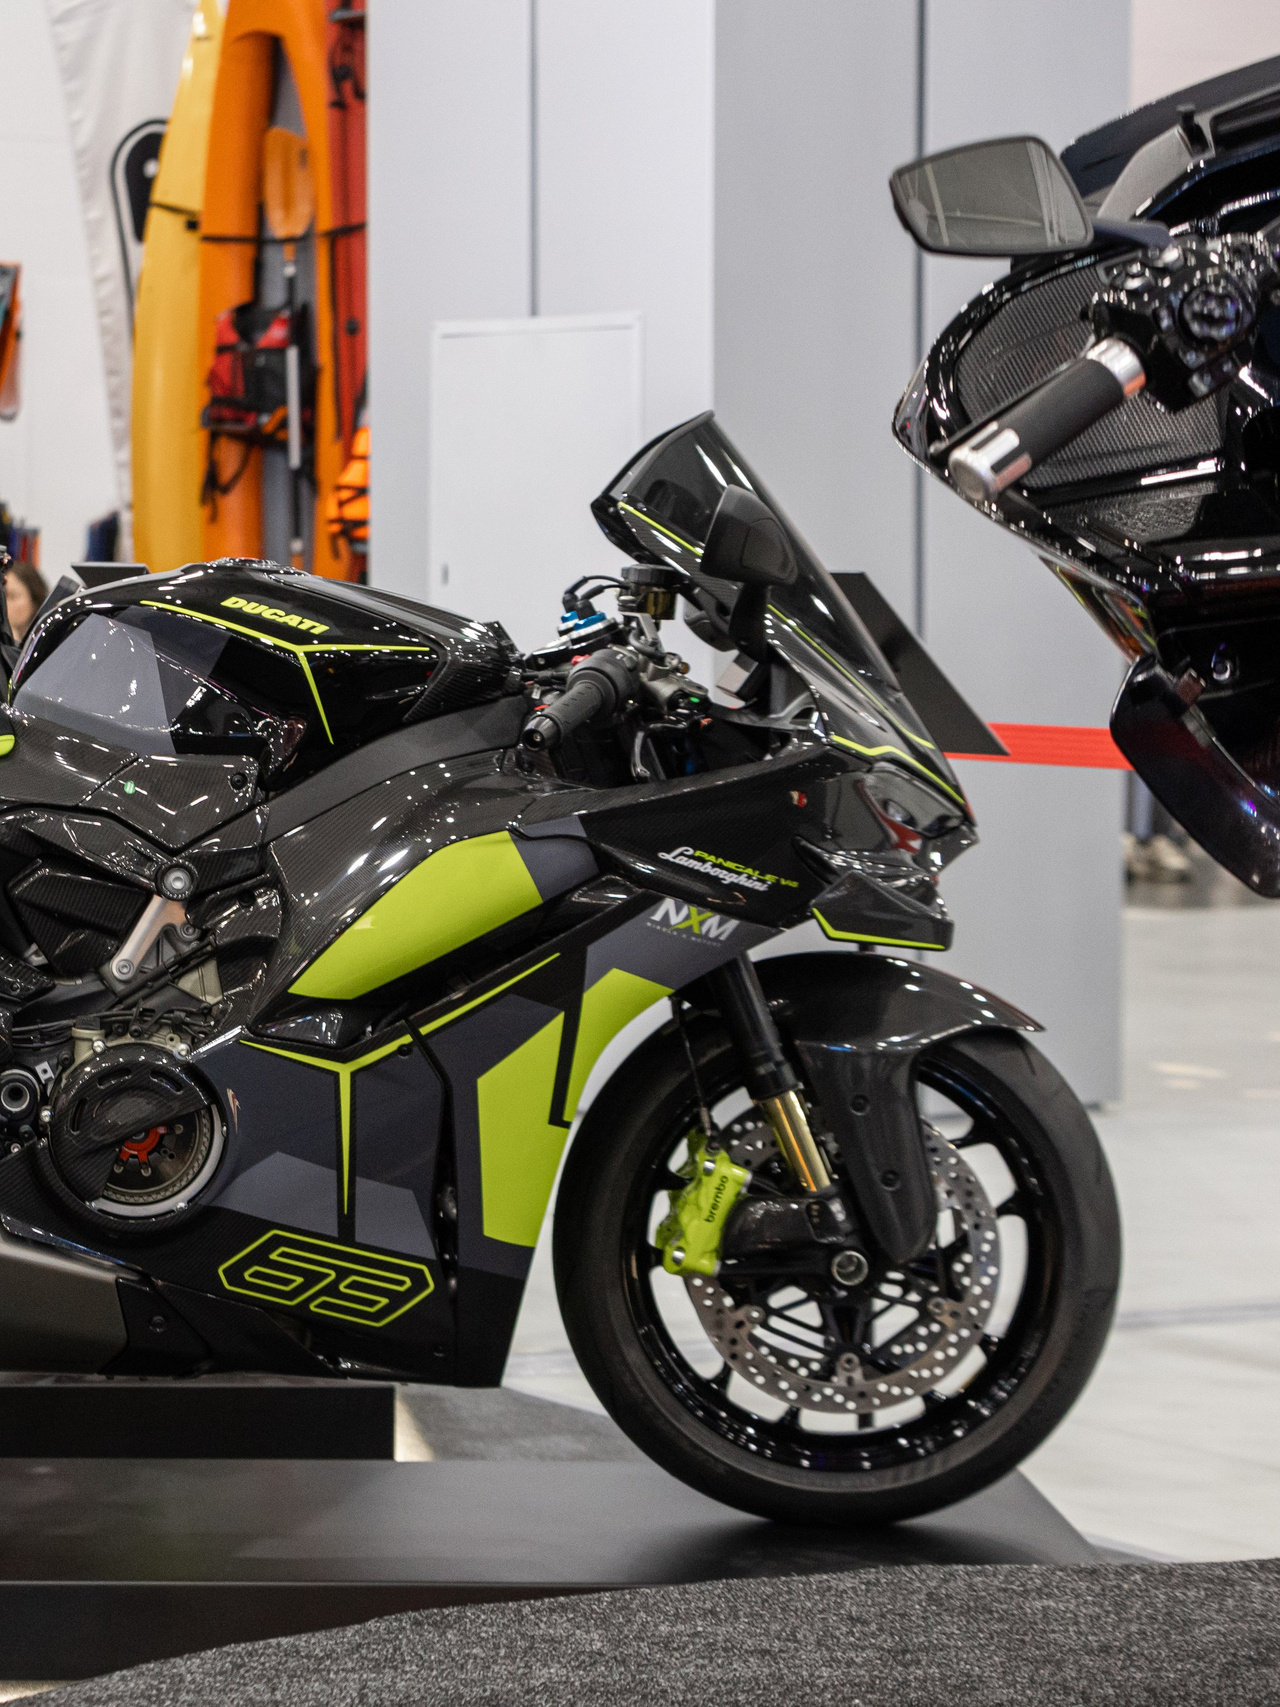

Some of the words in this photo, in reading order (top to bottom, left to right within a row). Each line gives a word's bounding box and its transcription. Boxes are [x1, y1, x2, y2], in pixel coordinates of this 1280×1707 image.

[221, 596, 330, 635] DUCATI
[658, 847, 771, 891] Lamborghini
[650, 898, 740, 941] NXM
[704, 1175, 729, 1222] brembo
